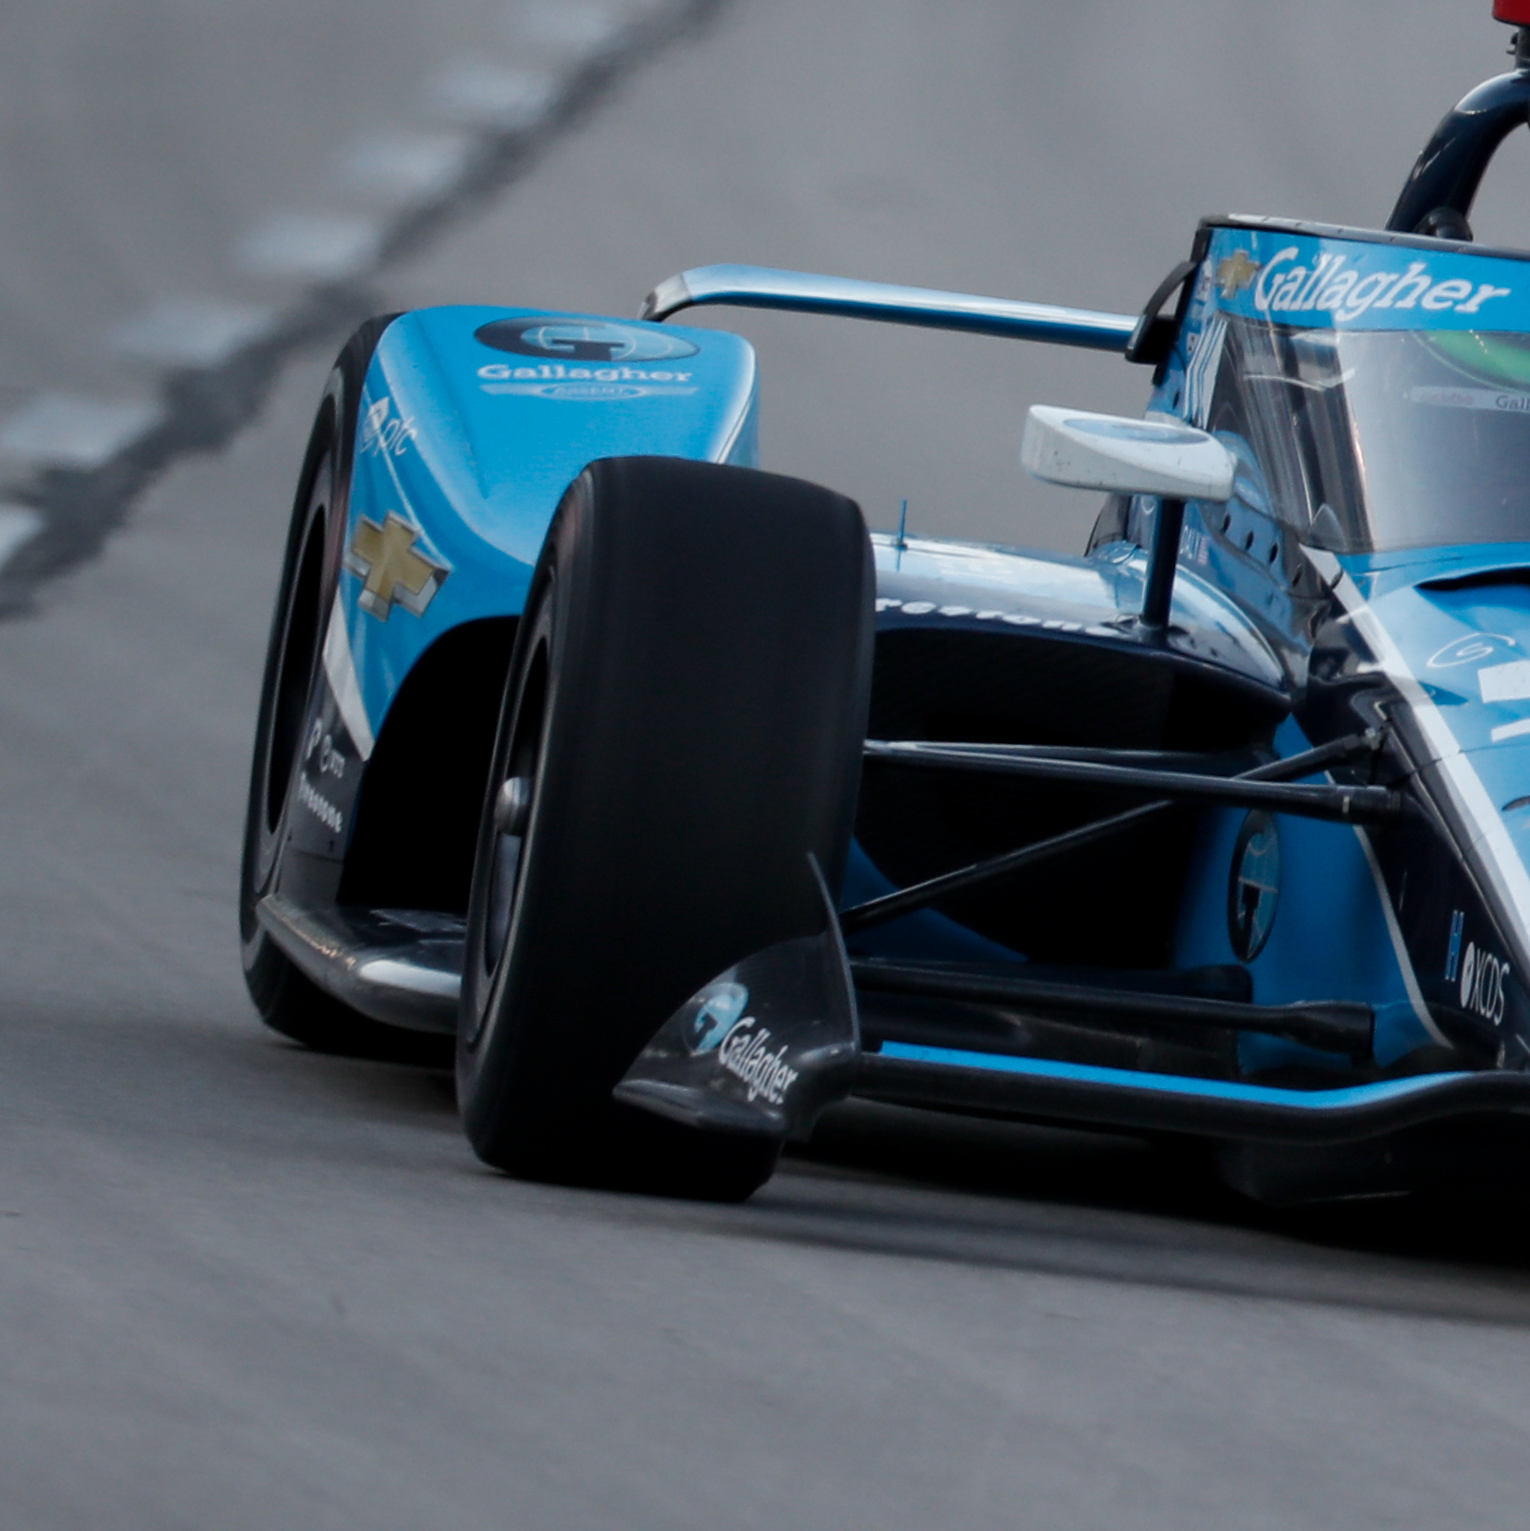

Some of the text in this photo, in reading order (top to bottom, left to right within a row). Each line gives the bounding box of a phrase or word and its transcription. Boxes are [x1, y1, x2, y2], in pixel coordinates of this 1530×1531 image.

[1254, 246, 1511, 322] Gallagher
[478, 364, 693, 382] Gallagher
[718, 1016, 799, 1105] Gallagher
